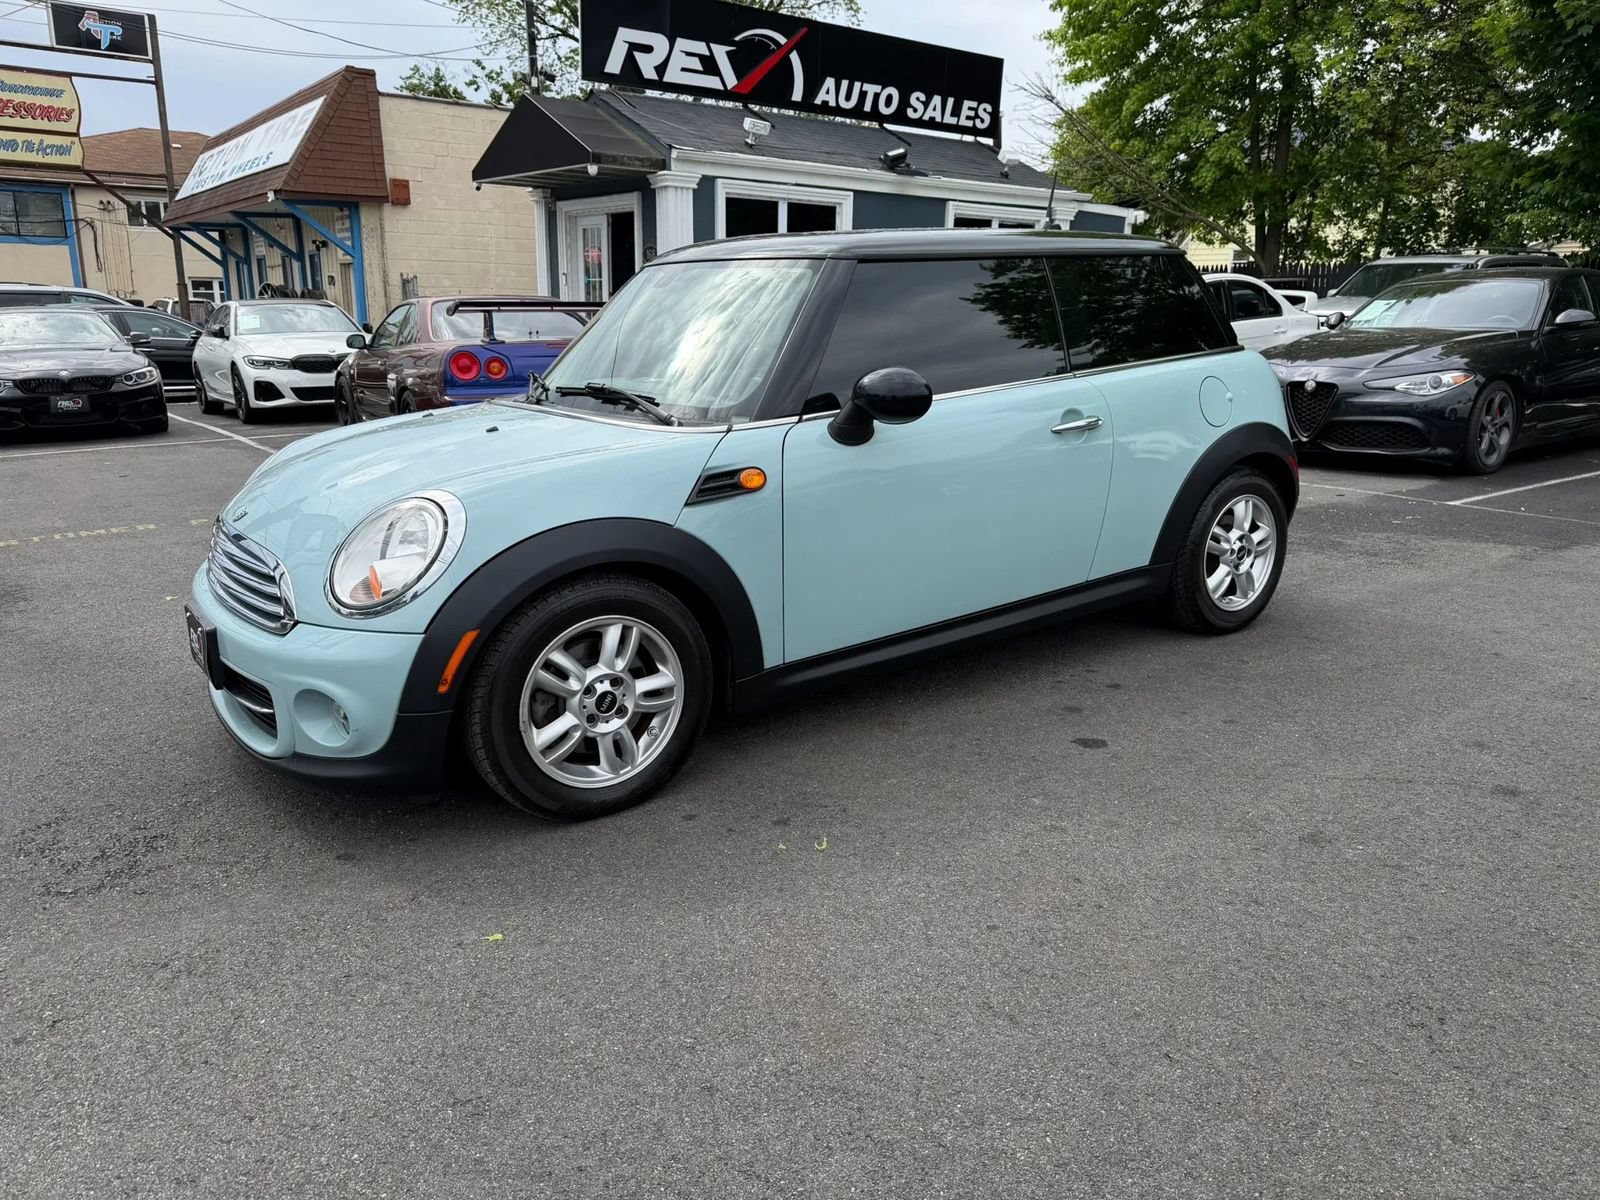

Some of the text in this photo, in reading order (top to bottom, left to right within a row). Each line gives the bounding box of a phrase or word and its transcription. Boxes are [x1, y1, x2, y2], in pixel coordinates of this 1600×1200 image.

[604, 26, 808, 95] REV
[0, 98, 75, 122] ESSORIES
[814, 76, 993, 129] AUTO SALES
[190, 106, 316, 179] ACTION TIRE
[190, 151, 274, 191] CUSTOM WHEELS
[600, 694, 613, 712] MINI
